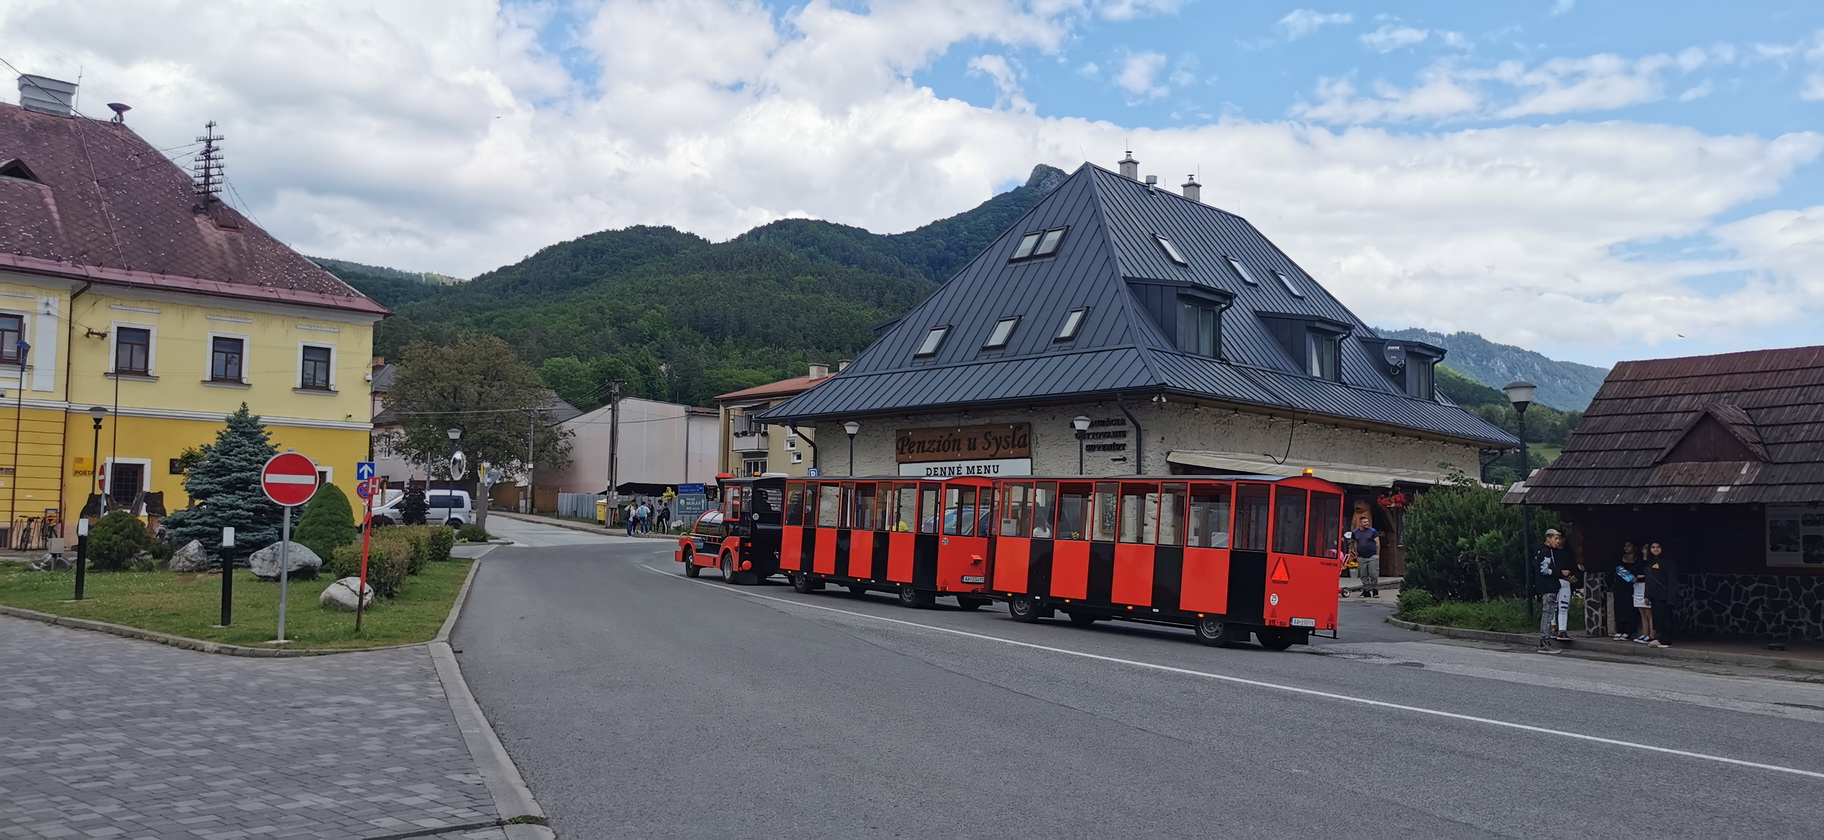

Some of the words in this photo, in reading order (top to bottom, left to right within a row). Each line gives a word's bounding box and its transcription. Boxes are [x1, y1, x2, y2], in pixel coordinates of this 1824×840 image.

[897, 433, 961, 455] Penzión
[966, 437, 977, 451] u
[926, 464, 962, 476] DENNÉ
[966, 465, 999, 475] MENU
